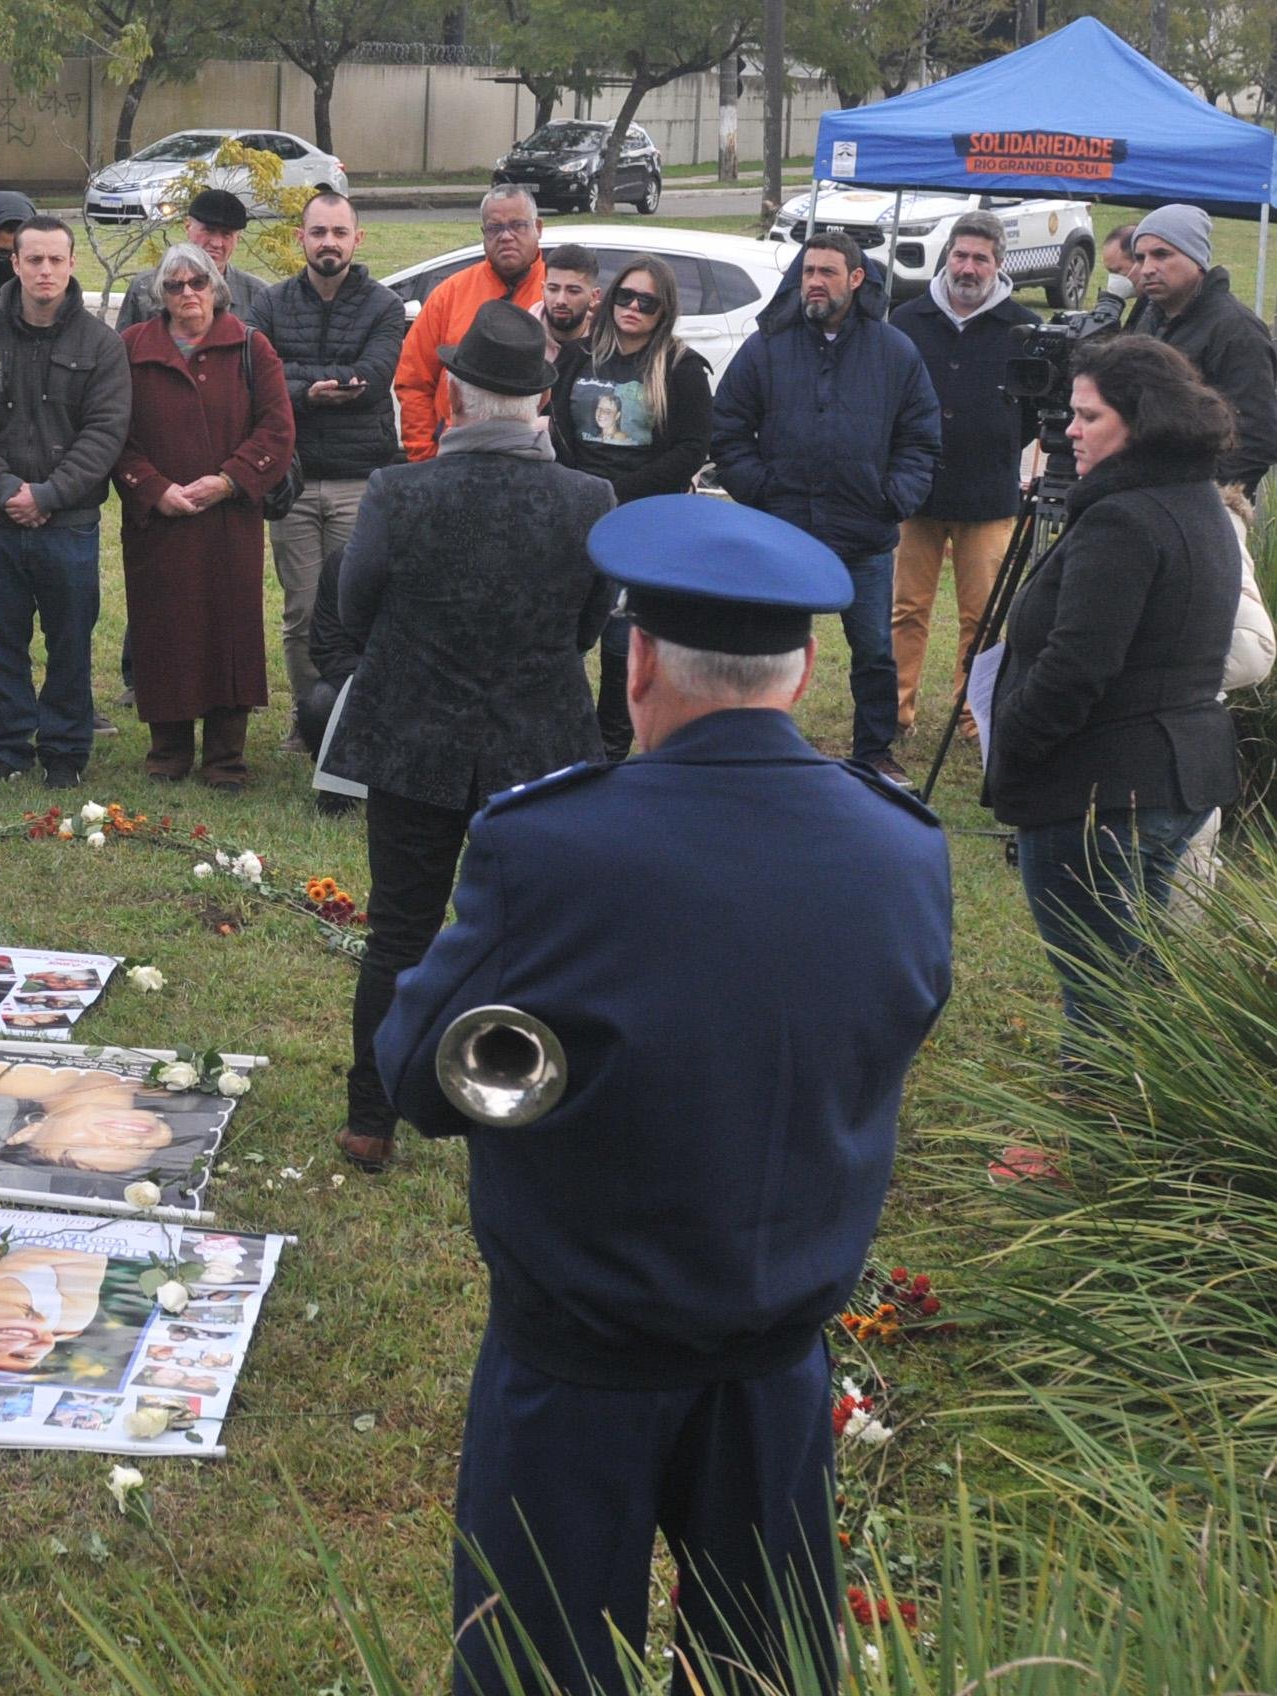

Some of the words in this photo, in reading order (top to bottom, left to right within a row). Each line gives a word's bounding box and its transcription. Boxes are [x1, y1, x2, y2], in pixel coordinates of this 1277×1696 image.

[969, 132, 1114, 158] SOLIDARIEDADE
[974, 160, 995, 170] RIO
[998, 161, 1051, 172] GRANDE
[1055, 162, 1074, 173] DO
[1077, 163, 1102, 175] SUL
